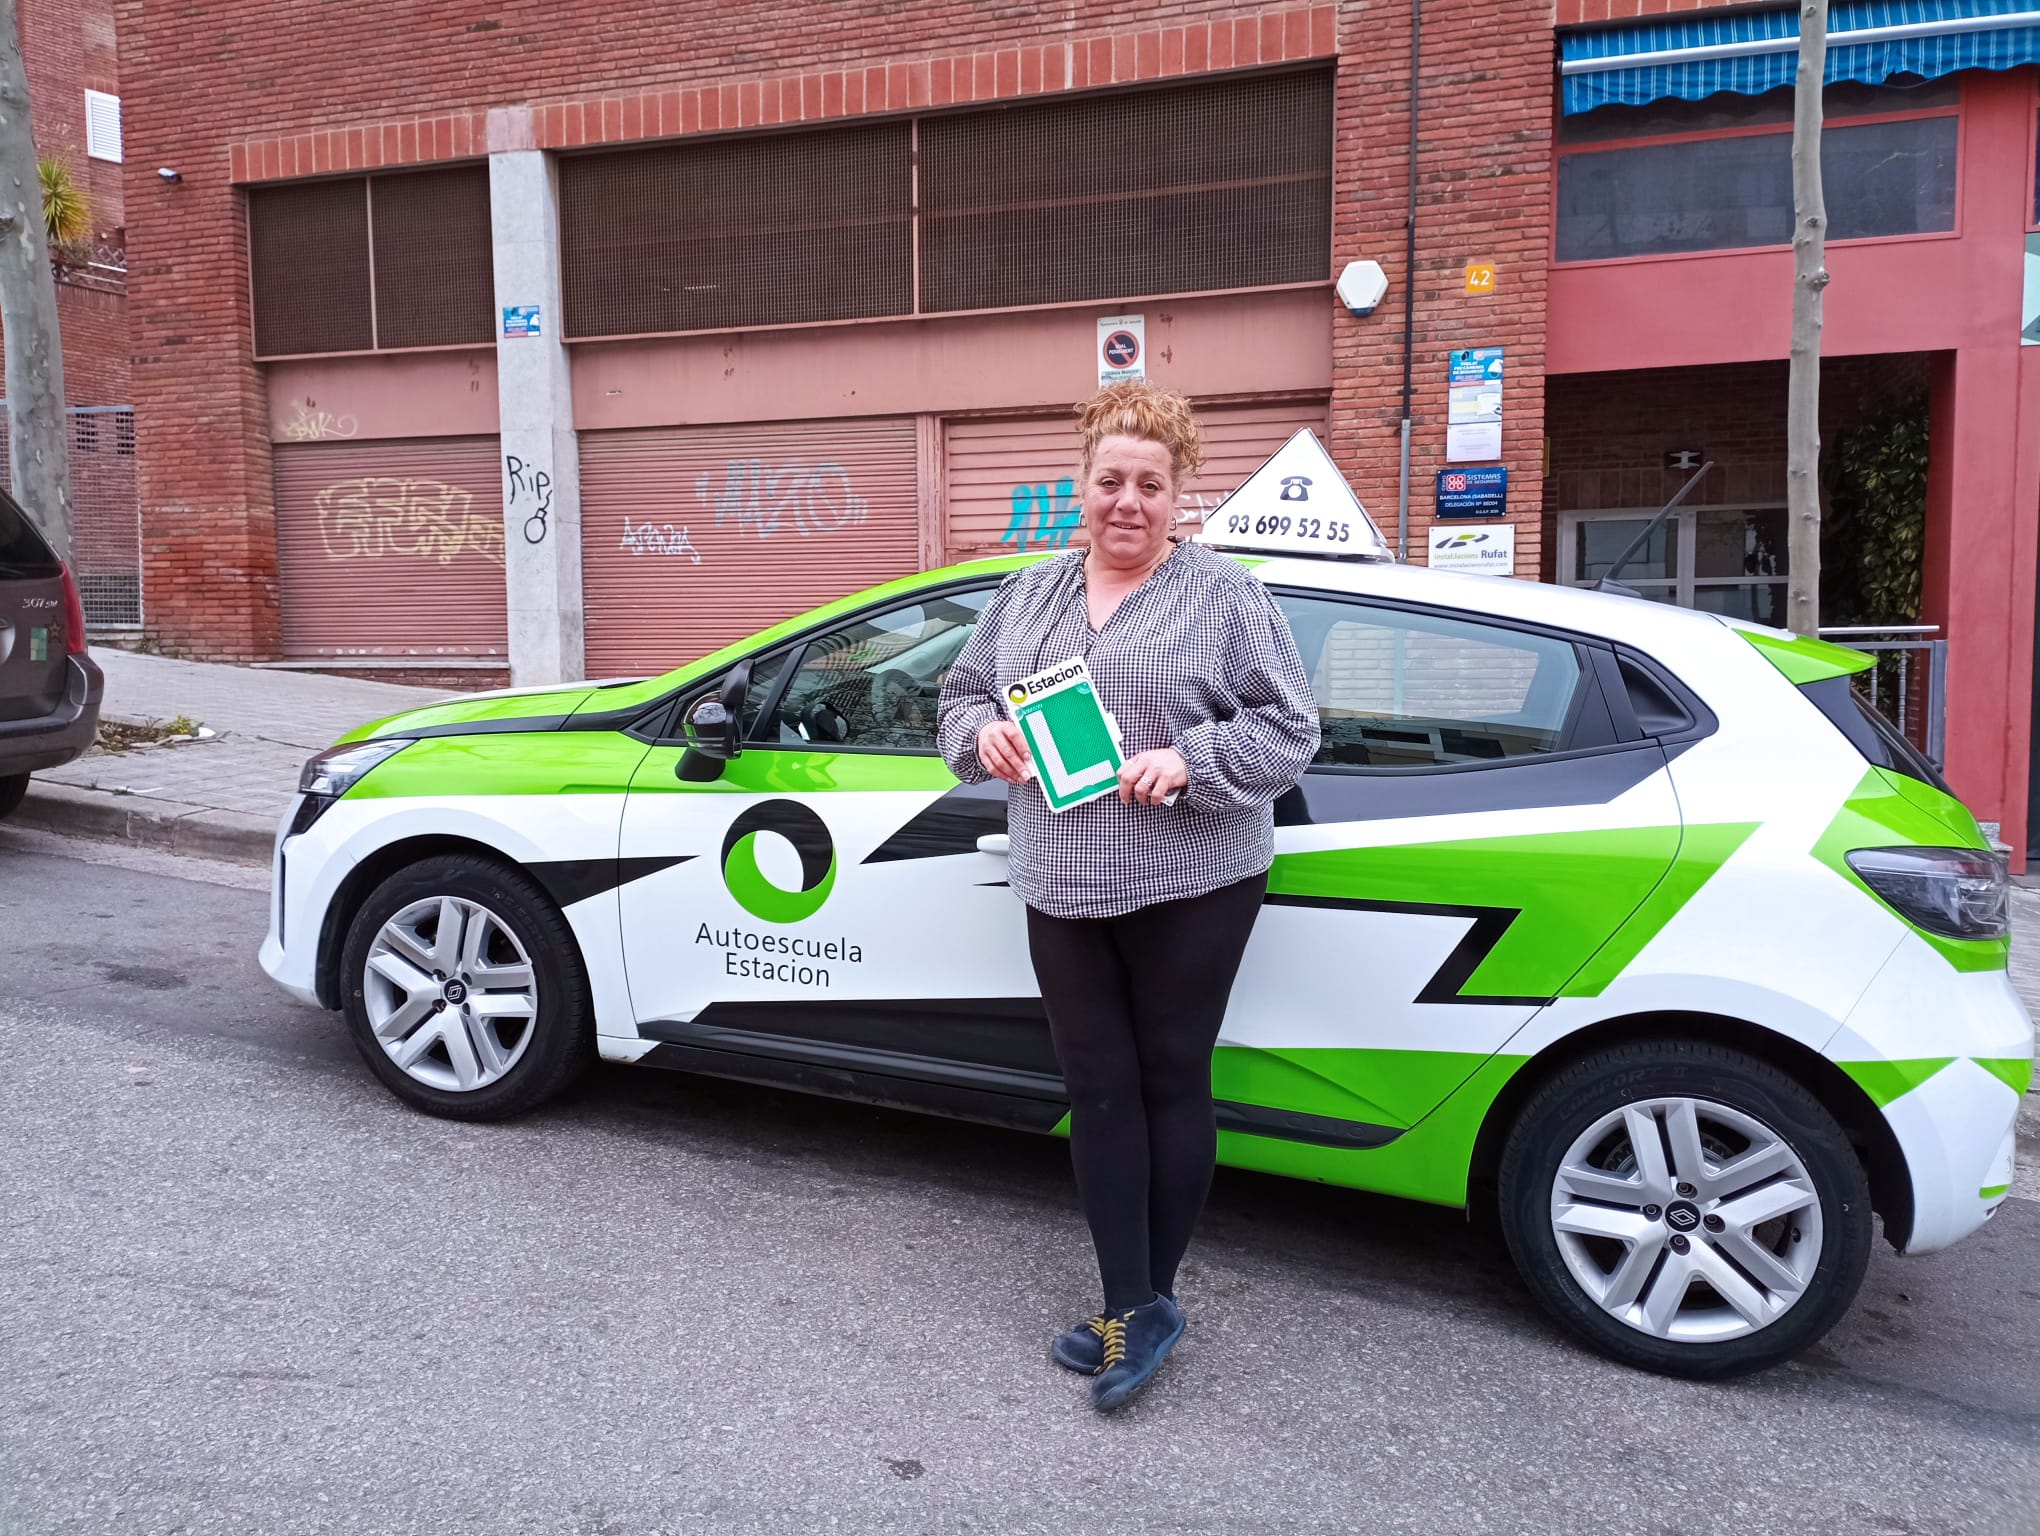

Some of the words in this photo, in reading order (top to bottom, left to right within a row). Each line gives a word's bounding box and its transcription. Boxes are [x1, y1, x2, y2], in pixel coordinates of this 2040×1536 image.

[1470, 270, 1491, 286] 42
[1228, 514, 1250, 535] 93
[1255, 515, 1292, 536] 699
[1297, 518, 1321, 539] 52
[1326, 521, 1350, 543] 55
[1481, 549, 1508, 559] Rufat
[22, 598, 45, 609] 307
[1026, 664, 1084, 695] Estacion
[1025, 709, 1117, 800] L
[695, 922, 862, 963] Autoescuela
[726, 952, 830, 987] Estacion
